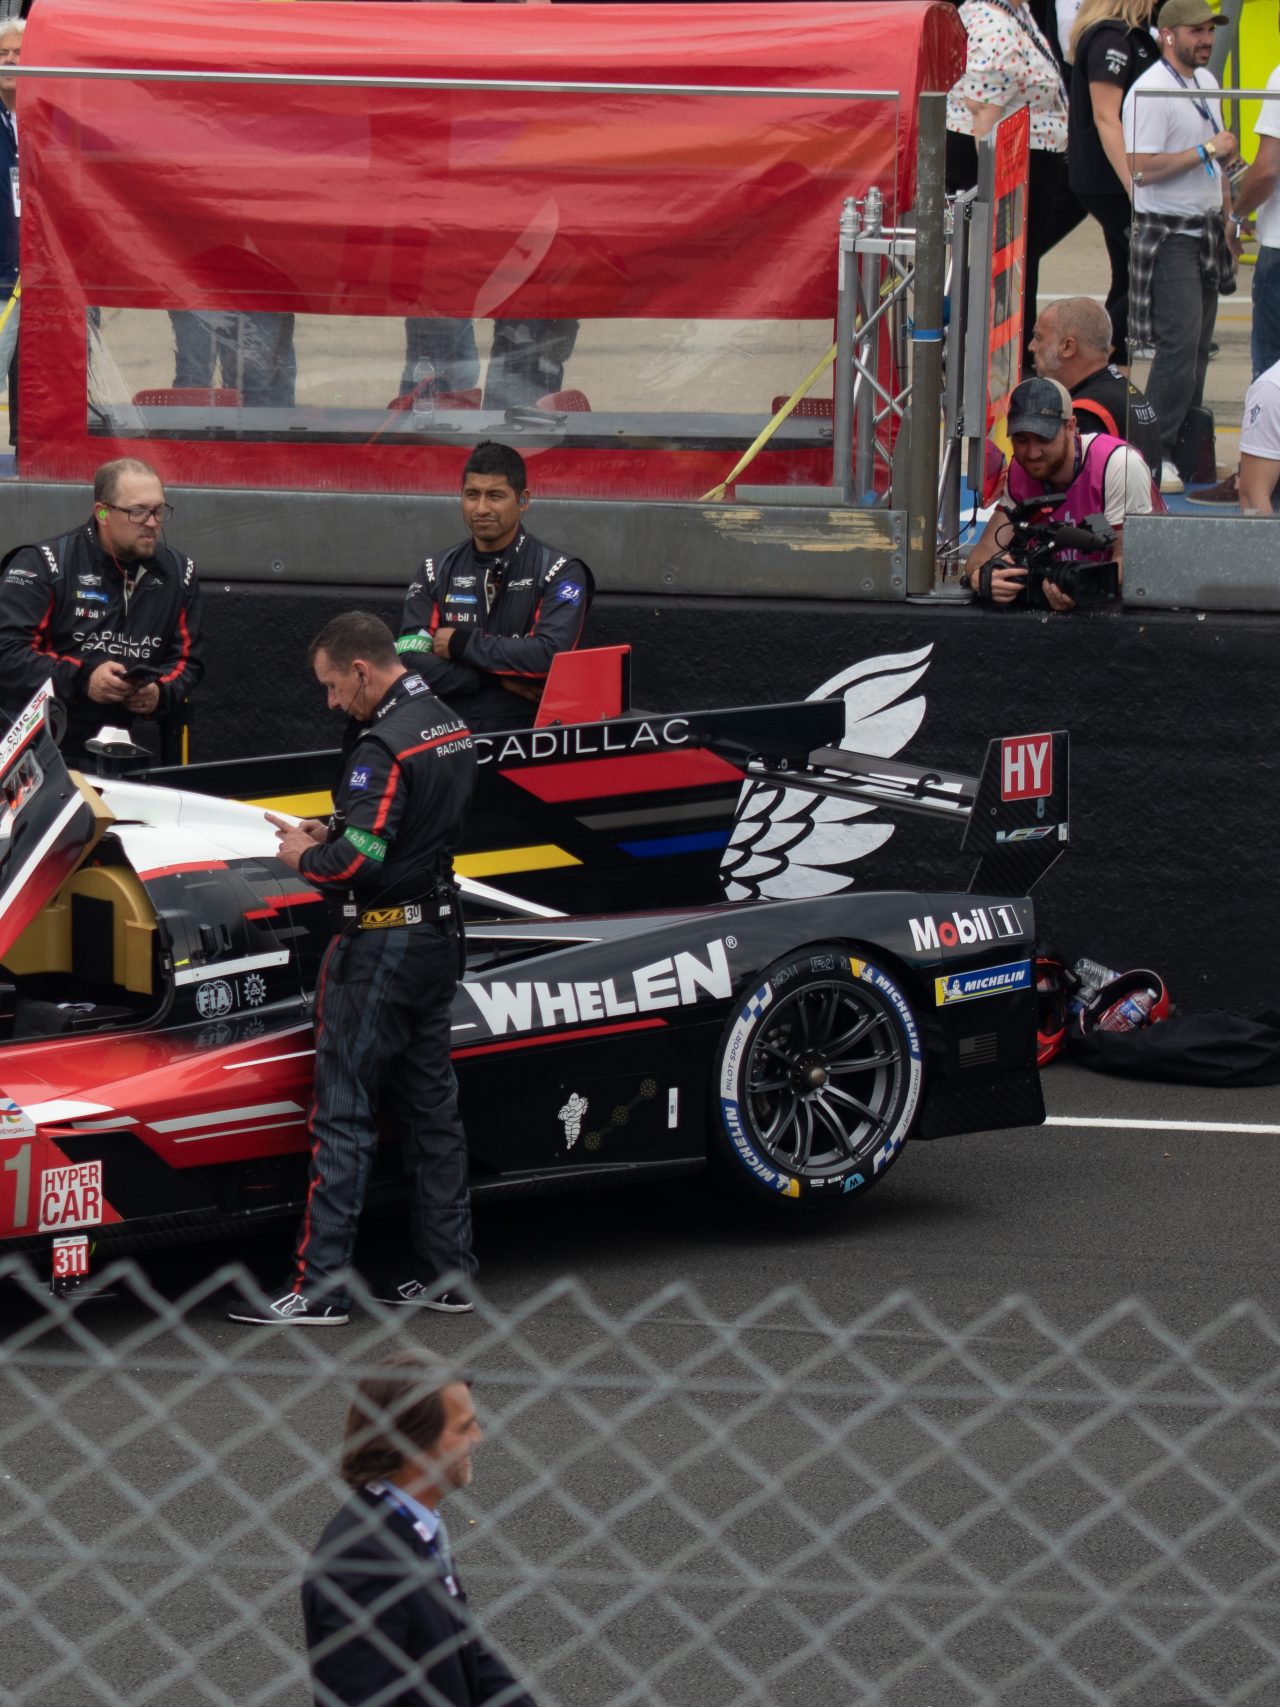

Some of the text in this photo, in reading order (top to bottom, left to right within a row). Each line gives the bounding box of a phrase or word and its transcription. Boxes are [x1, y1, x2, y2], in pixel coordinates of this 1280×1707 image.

[41, 546, 59, 574] HRX
[425, 558, 435, 582] HRX
[545, 557, 567, 583] HRX
[75, 608, 99, 618] Mobil
[446, 612, 469, 622] Mobil
[73, 631, 162, 648] CADILLAC
[81, 643, 151, 658] RACING
[420, 720, 468, 741] CADILLA
[474, 719, 690, 764] CADILLAC
[436, 738, 473, 757] RACING
[350, 772, 367, 783] 24h
[1004, 742, 1049, 793] HY
[407, 905, 420, 922] 30
[909, 907, 1014, 952] Mobil 1
[463, 938, 733, 1035] WHELEN
[964, 970, 1025, 992] MICHELIN
[875, 975, 920, 1053] MICHELIN
[726, 1030, 744, 1091] PILOT SPORT
[725, 1107, 776, 1182] MICHELIN
[44, 1164, 99, 1193] HYPER
[42, 1186, 100, 1226] CAR
[56, 1246, 88, 1274] 311
